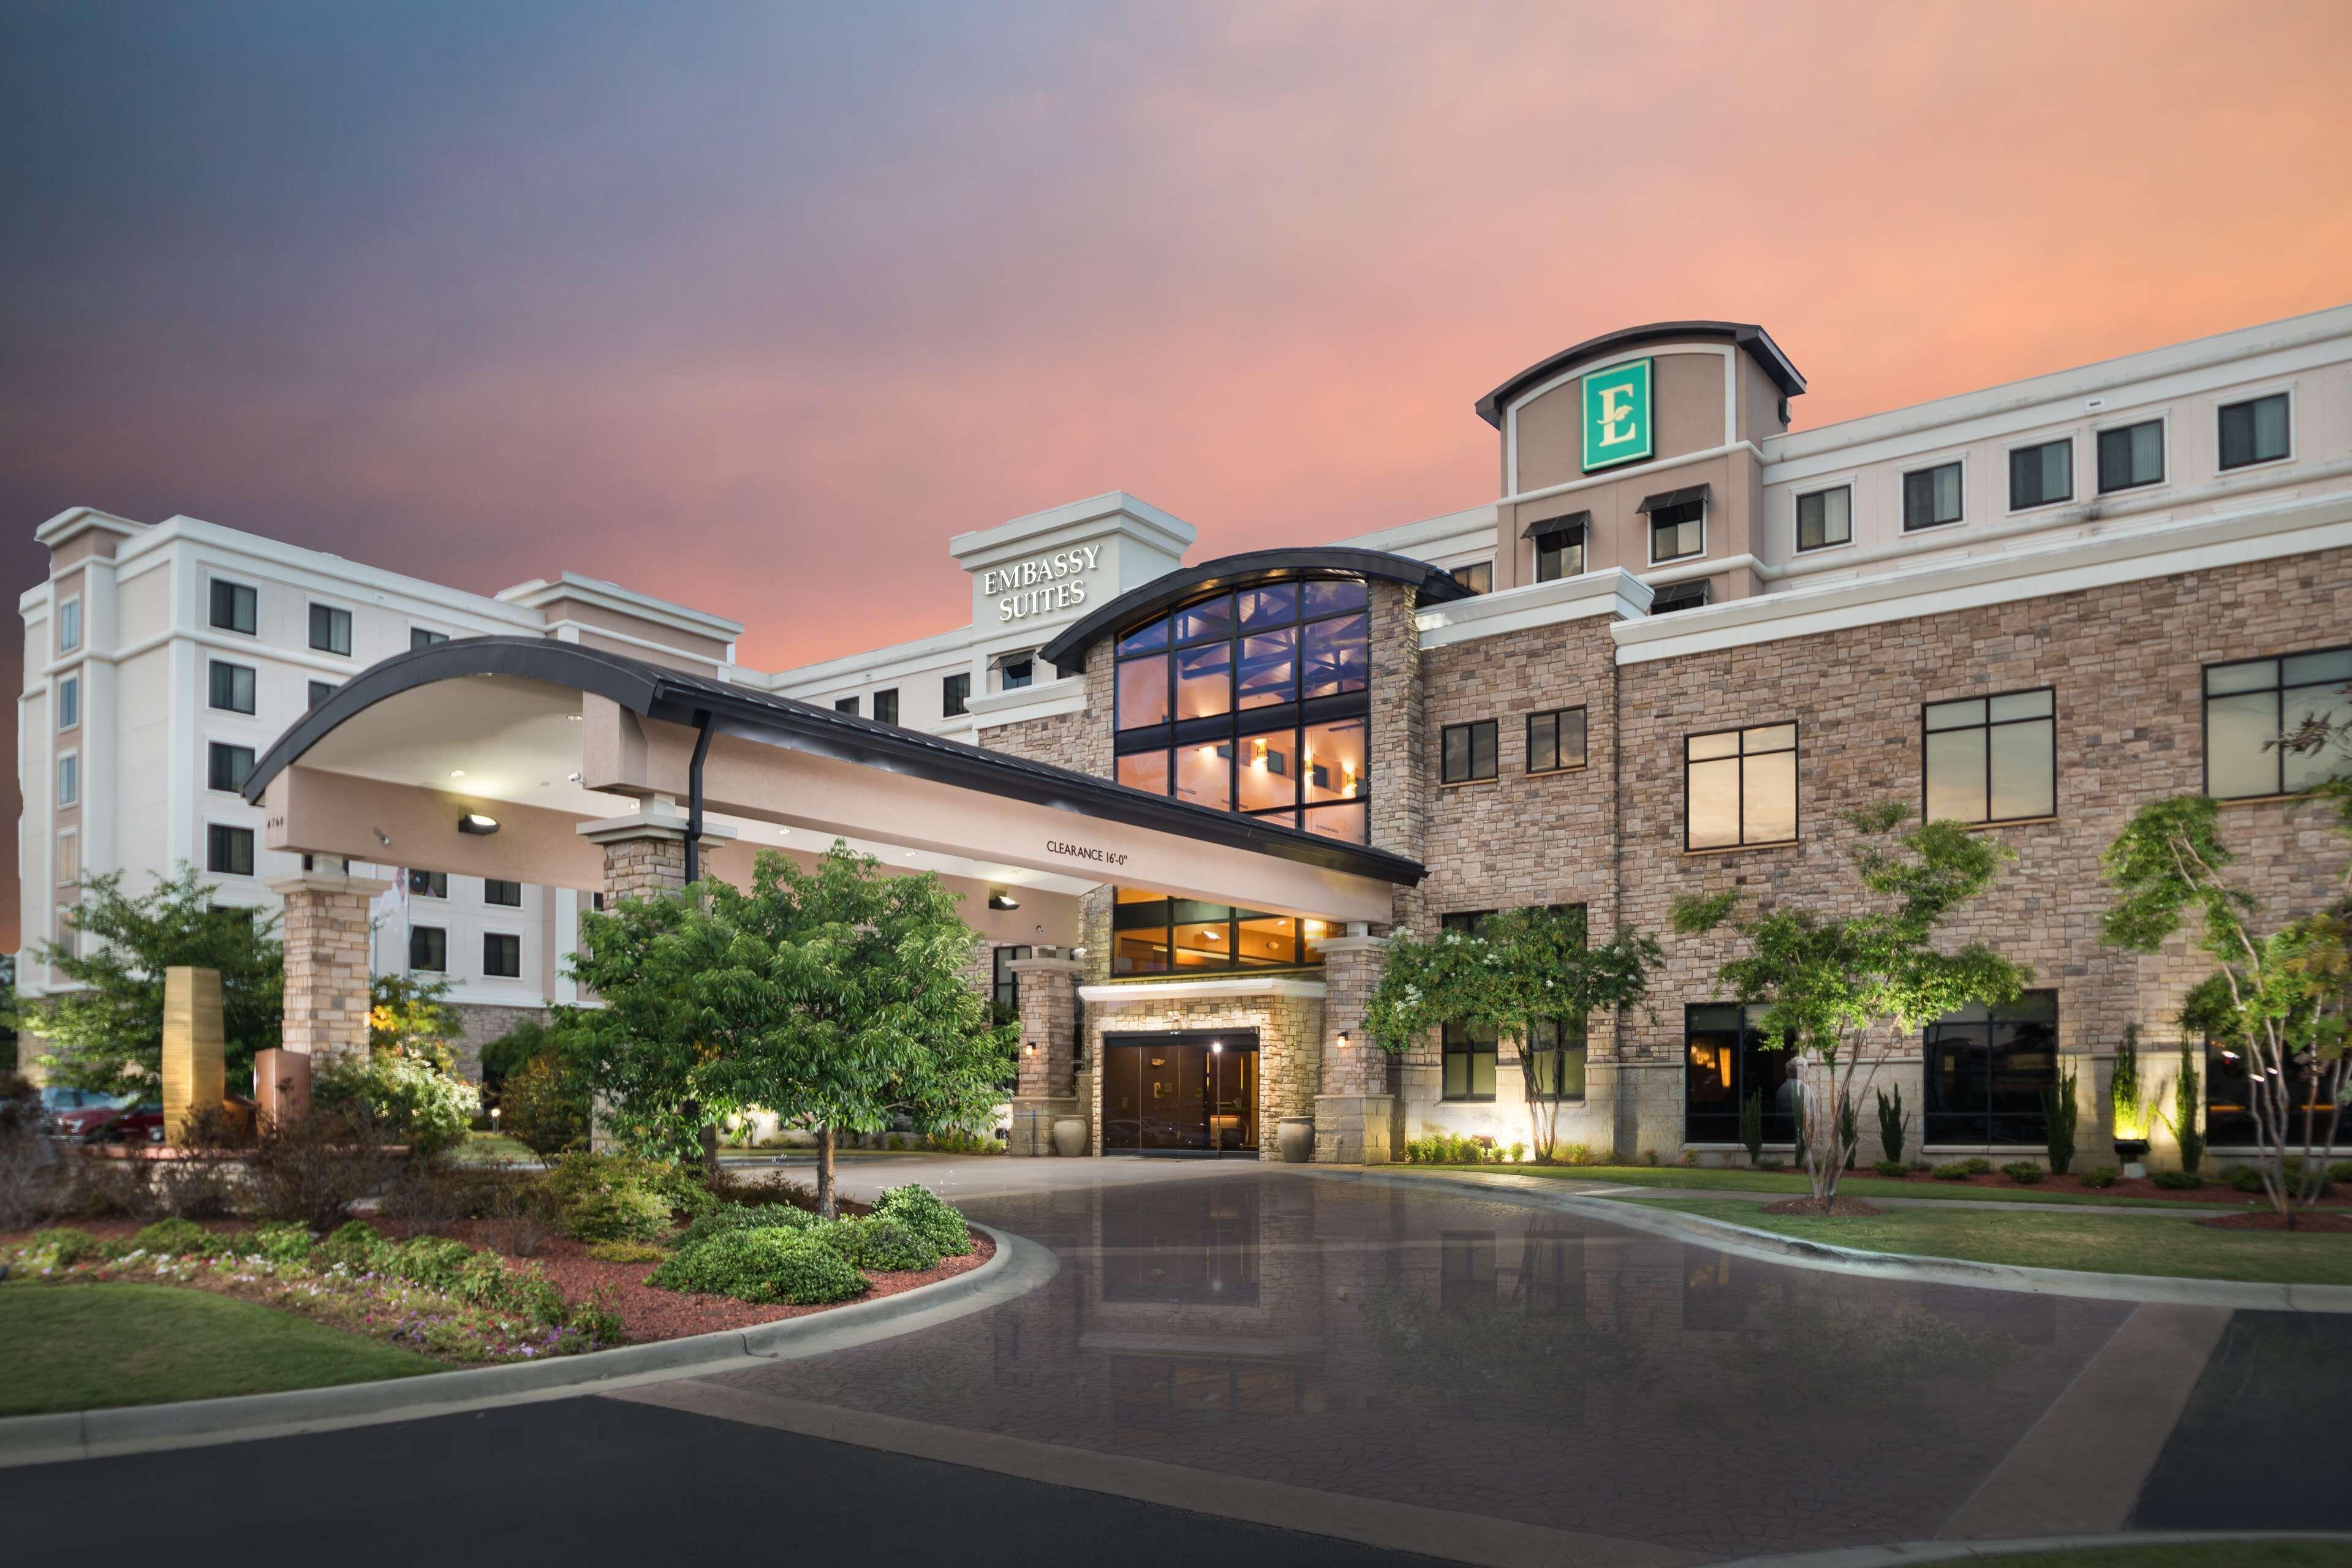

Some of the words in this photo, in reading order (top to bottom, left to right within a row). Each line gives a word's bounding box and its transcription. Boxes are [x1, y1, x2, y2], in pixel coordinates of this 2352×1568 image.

[1597, 383, 1636, 447] E
[983, 544, 1102, 596] EMBASSY
[1000, 580, 1085, 621] SUITES
[1046, 840, 1103, 862] CLEARANCE
[1106, 852, 1127, 865] 16'-0"
